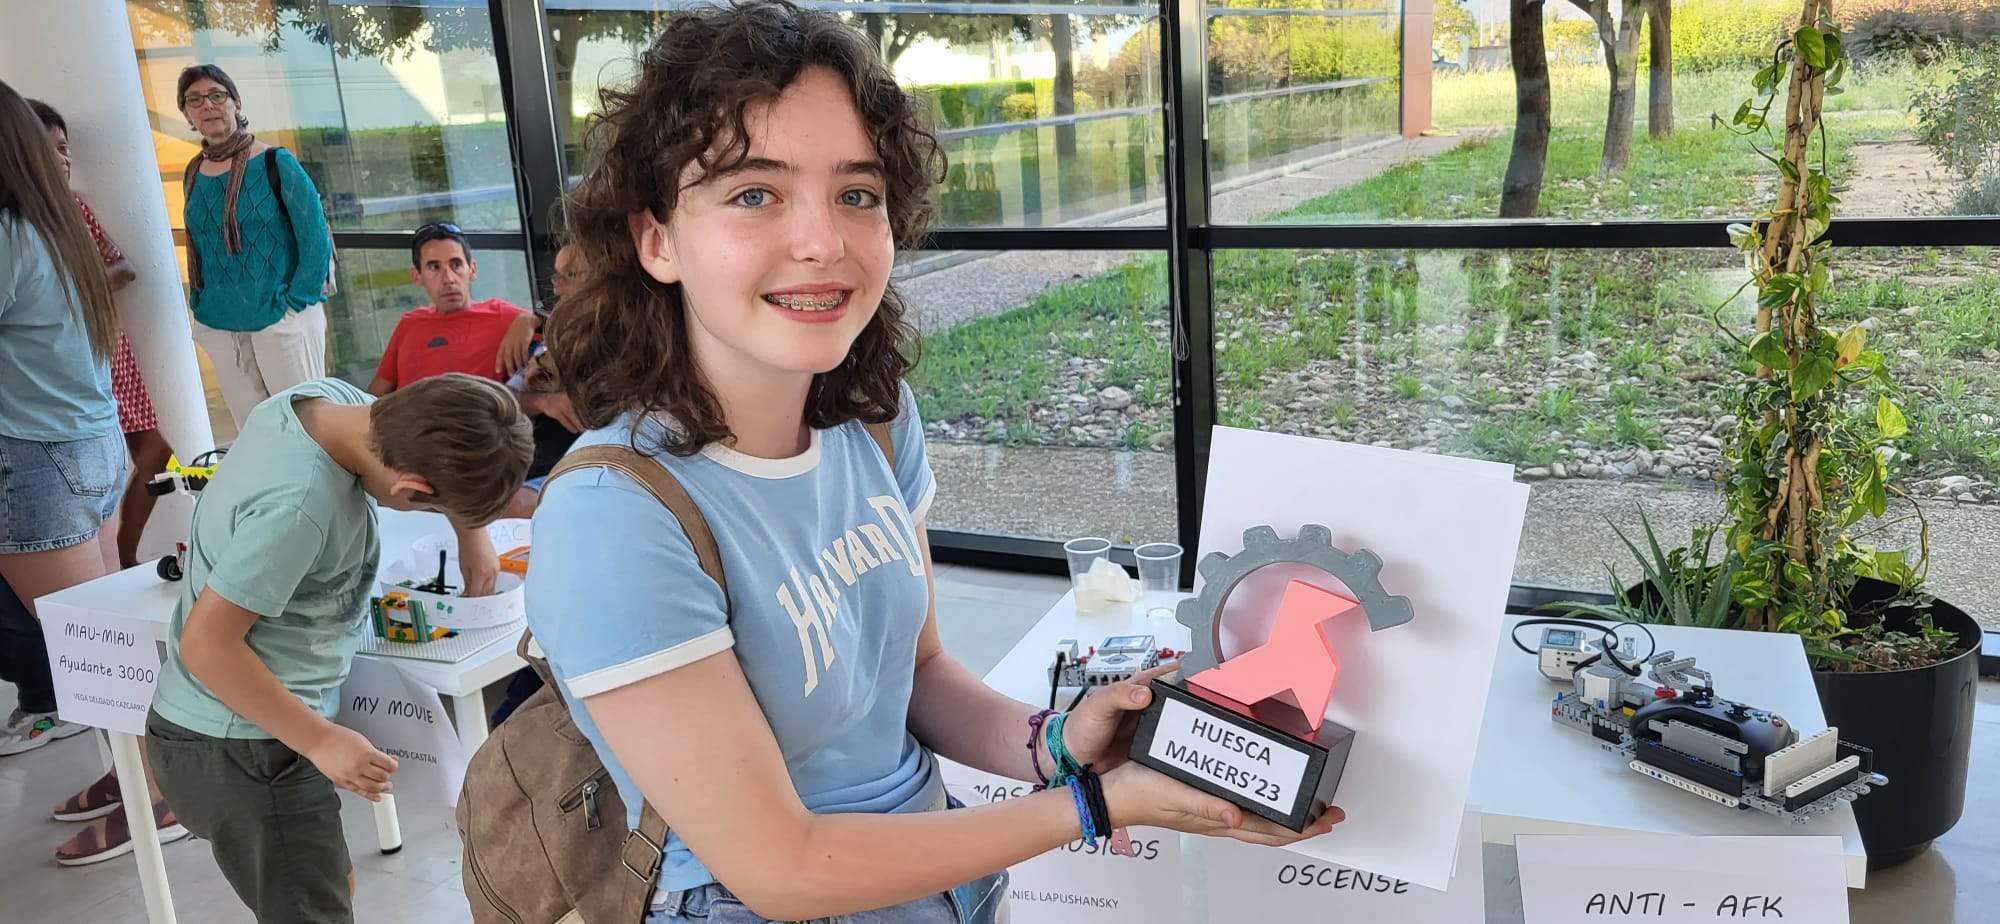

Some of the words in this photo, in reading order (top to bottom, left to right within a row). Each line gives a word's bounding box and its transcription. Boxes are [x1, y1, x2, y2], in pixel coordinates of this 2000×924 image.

[65, 622, 134, 647] MIAU-MIAU
[60, 655, 112, 676] Ayudante
[118, 664, 154, 684] 3000
[352, 696, 379, 714] MY
[387, 700, 434, 724] MOVIE
[1191, 717, 1271, 766] HUESCA
[1060, 838, 1160, 860] USIOS
[1277, 864, 1409, 894] OSCENSE
[1009, 889, 1036, 901] NIEL
[1039, 891, 1119, 909] LAPUSHANSKY
[1585, 891, 1666, 916] ANTI
[1716, 894, 1783, 918] AFK
